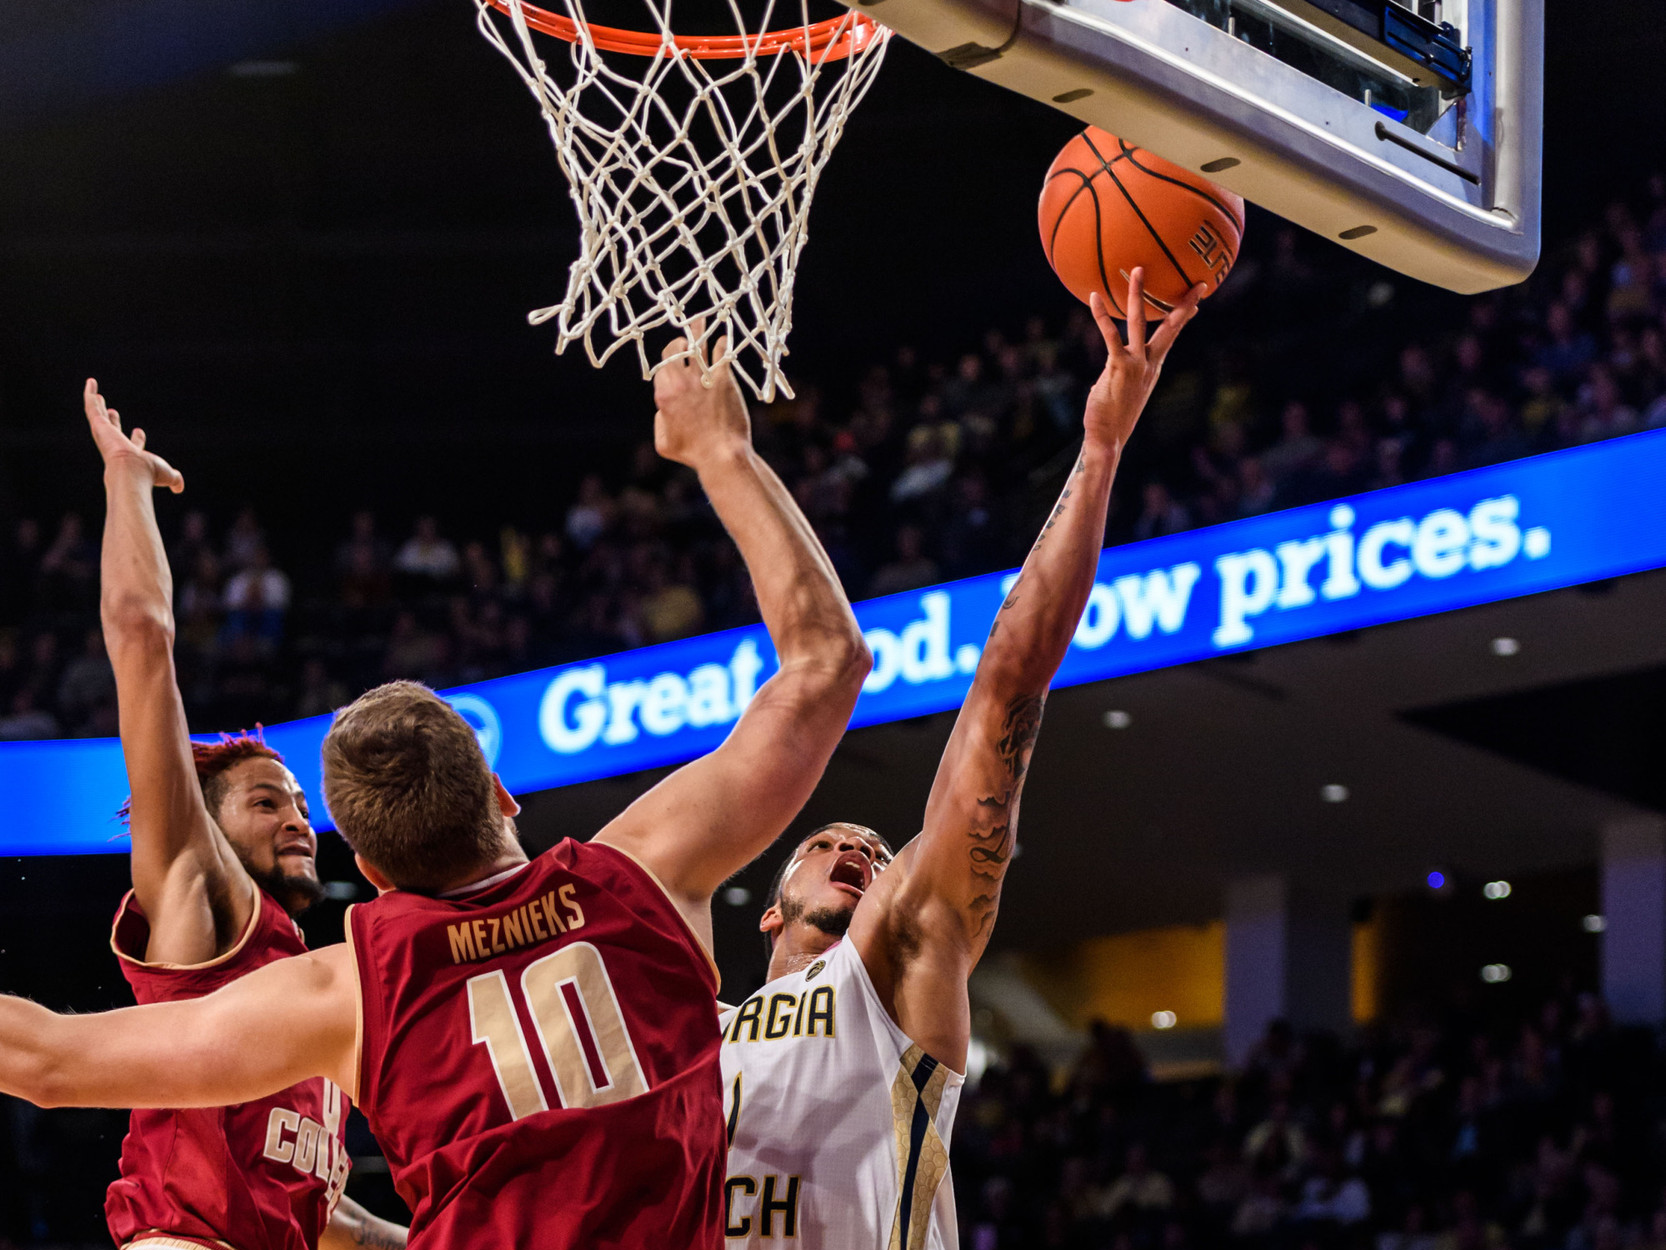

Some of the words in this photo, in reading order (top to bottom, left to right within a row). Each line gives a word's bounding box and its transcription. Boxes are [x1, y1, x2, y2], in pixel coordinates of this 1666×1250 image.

[538, 636, 764, 755] Great
[864, 589, 981, 694] od.
[1002, 561, 1201, 651] ow
[1213, 495, 1552, 649] prices.
[447, 883, 586, 964] MEZNIEKS
[466, 941, 650, 1122] 10
